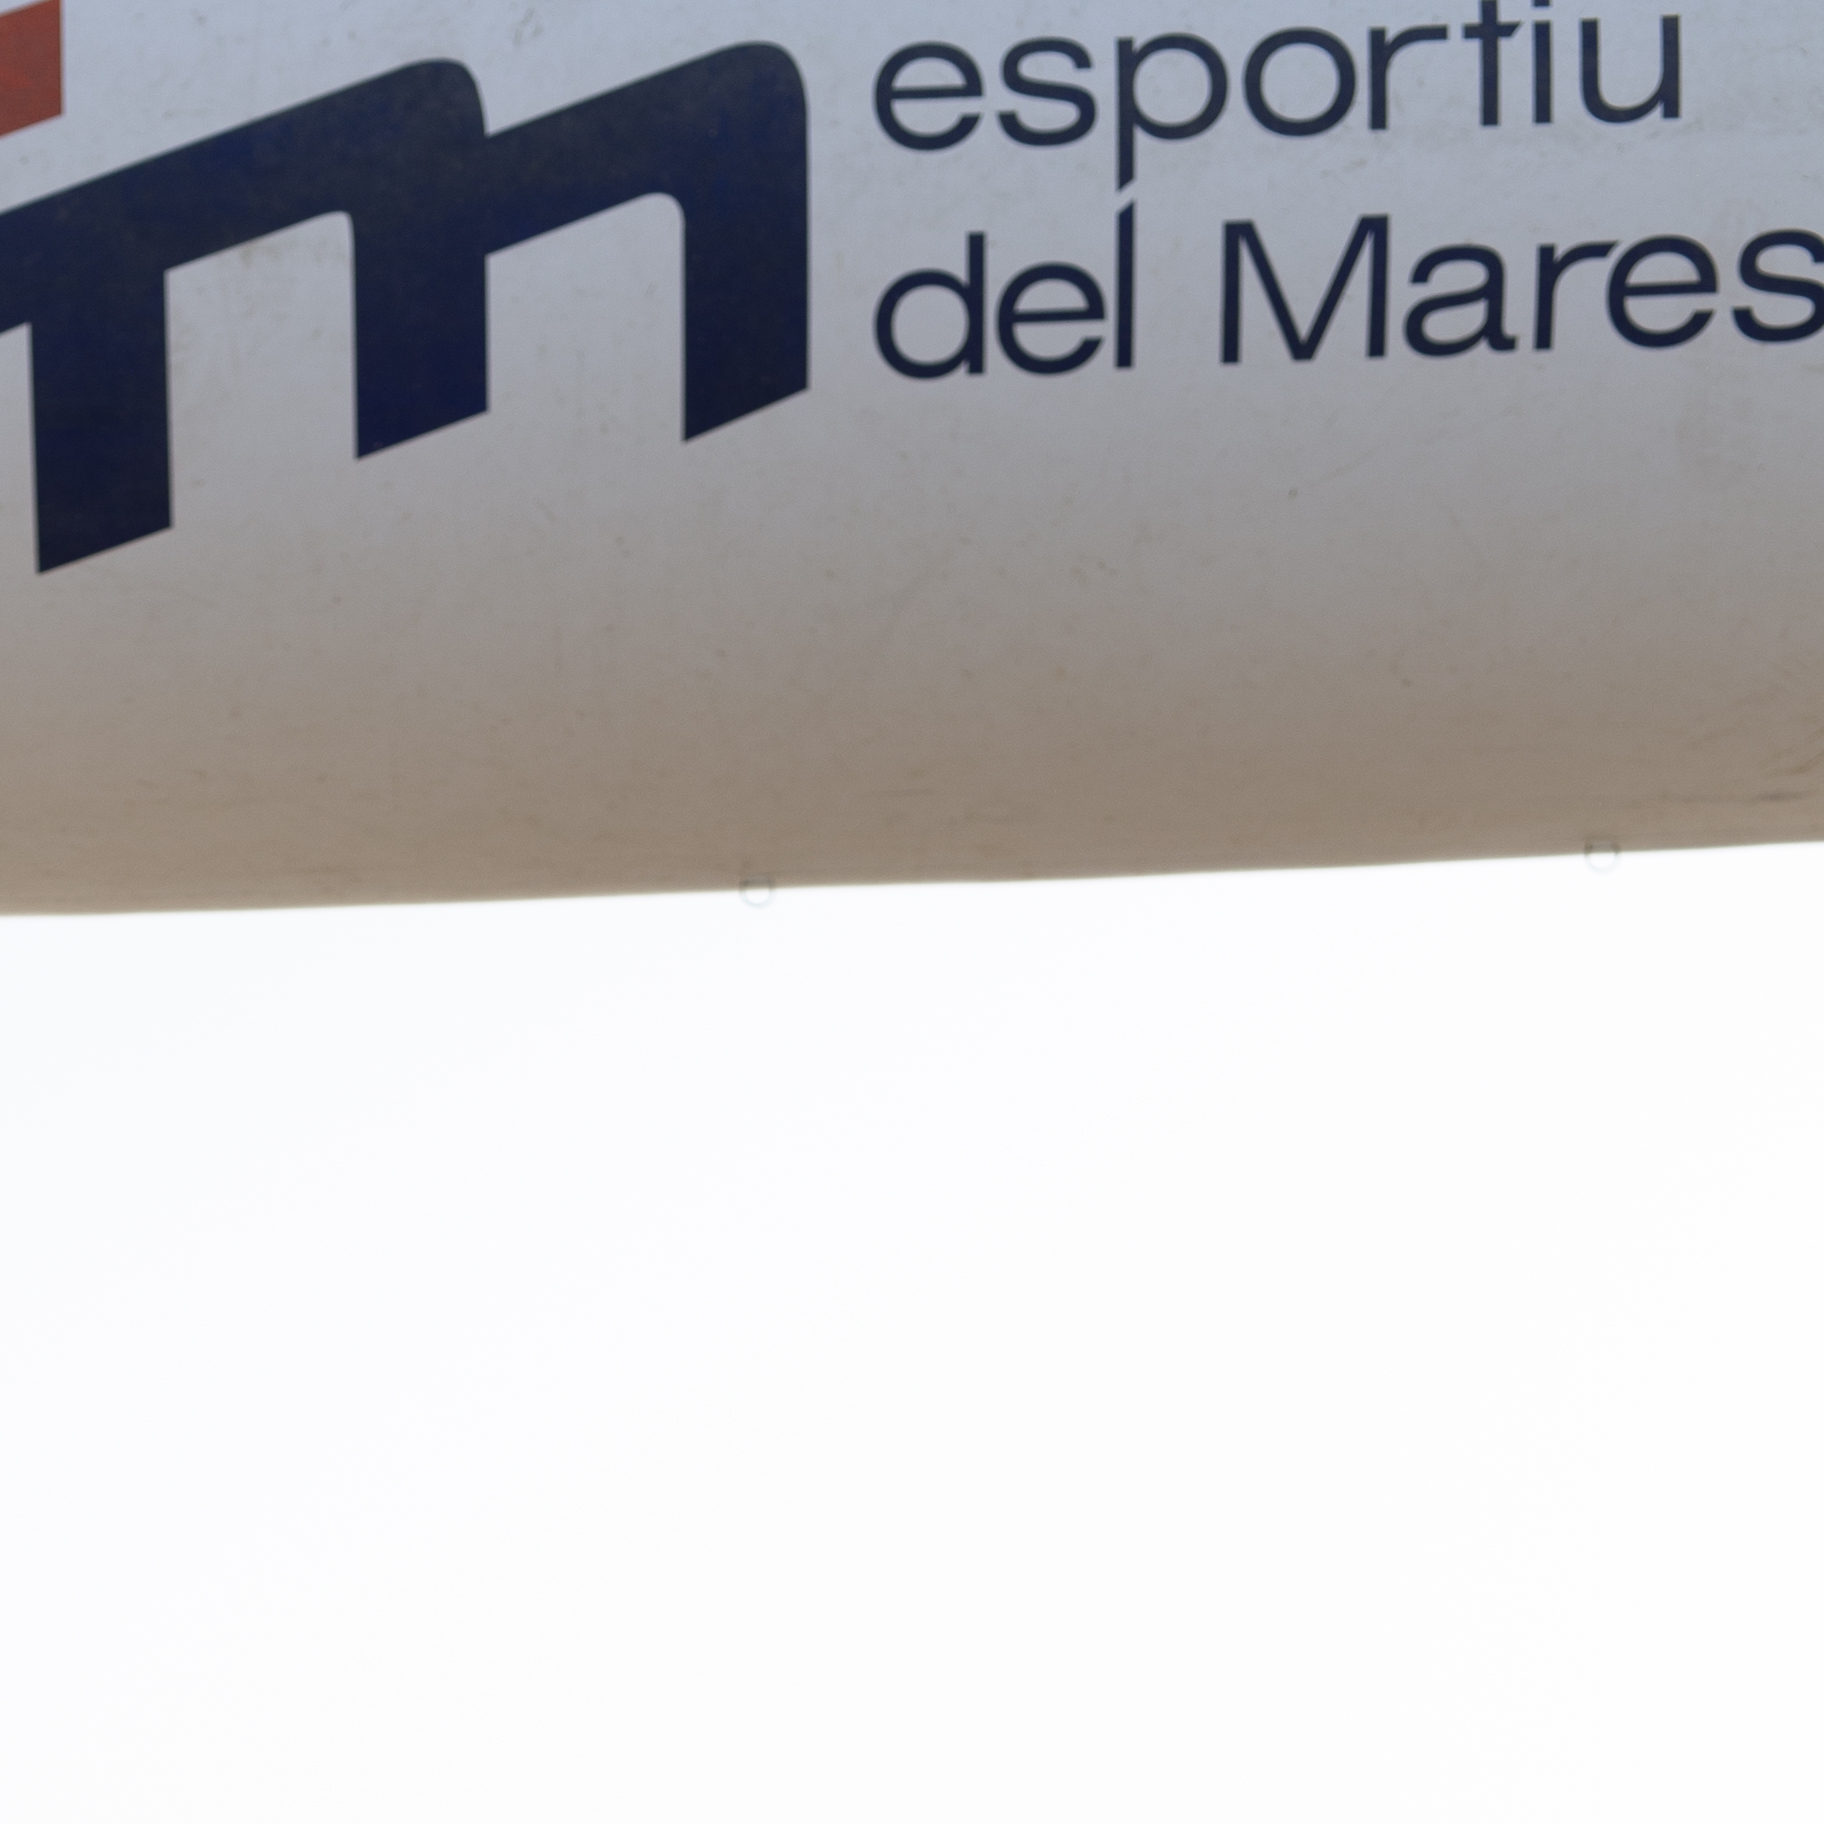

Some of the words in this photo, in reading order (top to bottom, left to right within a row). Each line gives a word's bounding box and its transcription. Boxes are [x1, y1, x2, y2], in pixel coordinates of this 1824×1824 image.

[872, 0, 1681, 192] esportiu
[872, 200, 1136, 381] del
[1219, 213, 1824, 366] Mares
